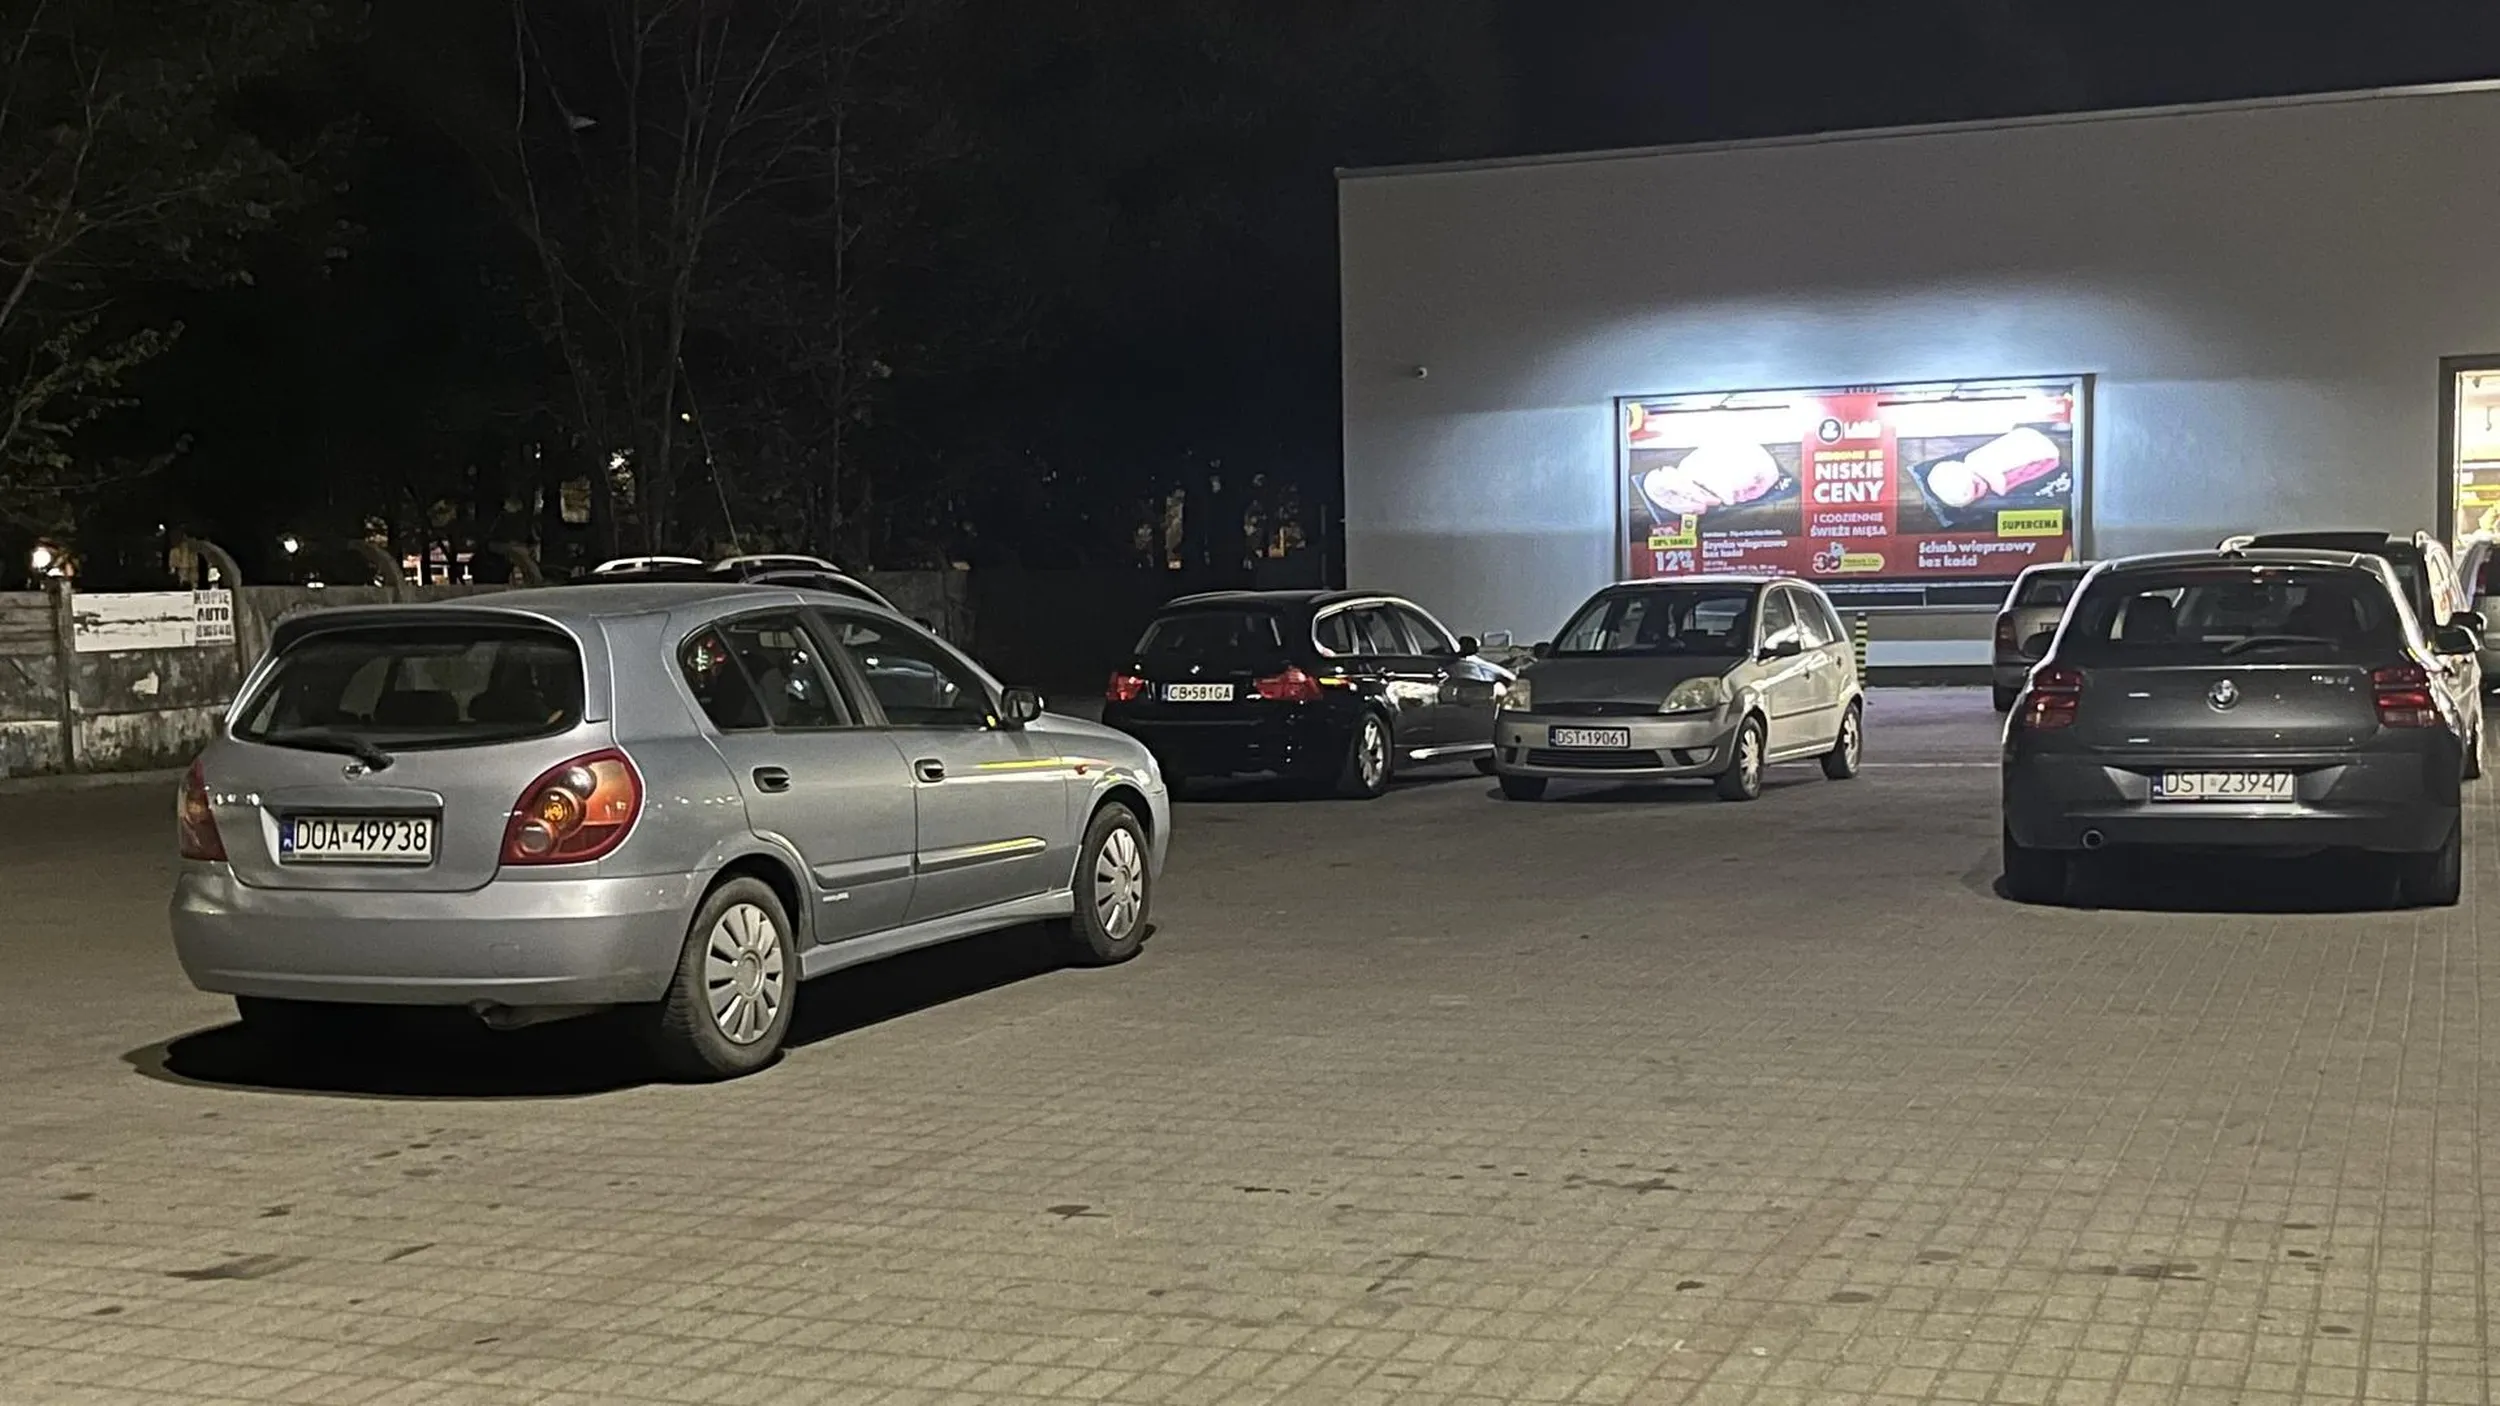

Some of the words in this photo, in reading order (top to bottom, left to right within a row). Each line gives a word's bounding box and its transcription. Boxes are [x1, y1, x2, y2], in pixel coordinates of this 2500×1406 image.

[1814, 461, 1885, 481] NISKIE
[1813, 480, 1885, 504] CENY
[2001, 519, 2059, 531] SUPERCENA
[1918, 540, 1957, 554] Schab
[1958, 539, 2036, 556] wieprzowy
[1918, 554, 1942, 568] bez
[1943, 553, 1978, 567] kości
[197, 607, 229, 622] AUTO
